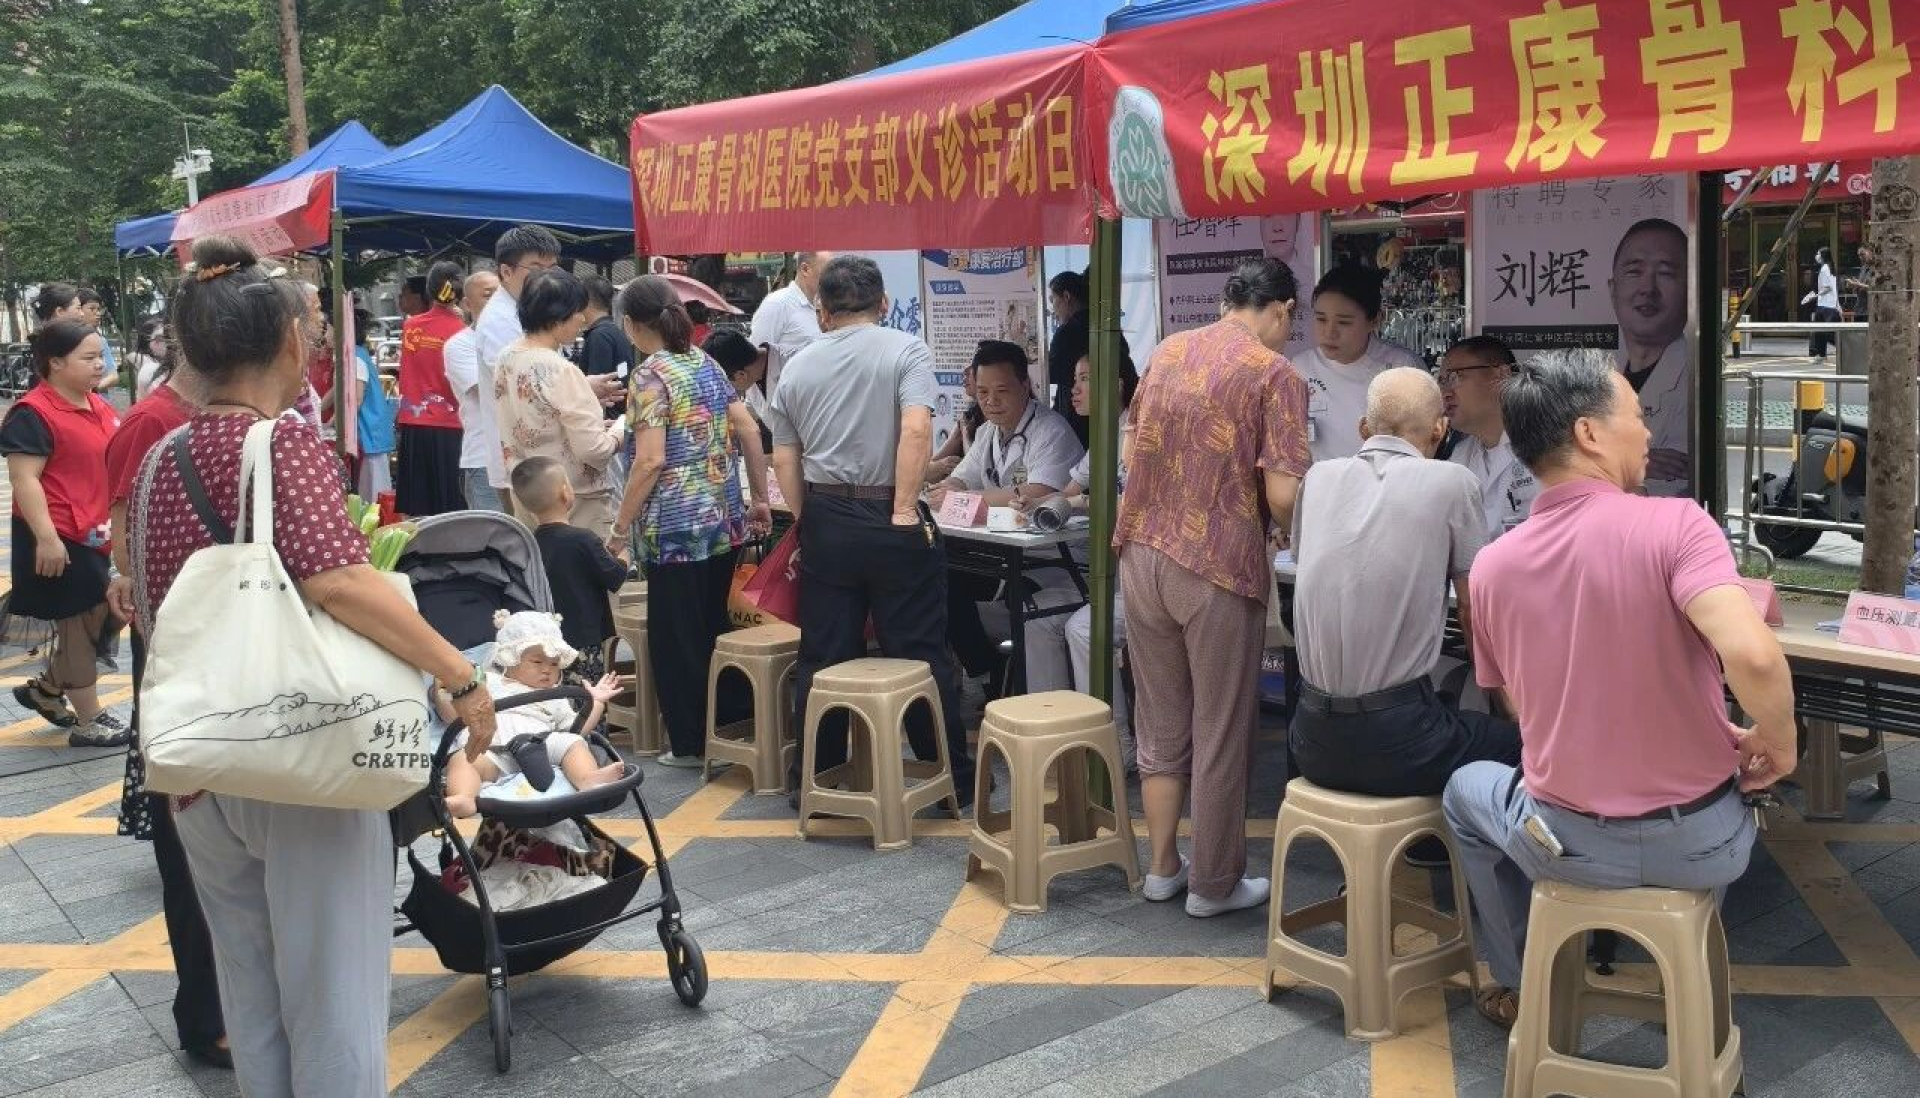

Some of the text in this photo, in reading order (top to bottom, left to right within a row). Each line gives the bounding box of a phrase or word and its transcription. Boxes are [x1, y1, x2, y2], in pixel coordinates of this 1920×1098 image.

[1201, 0, 1912, 204] 深圳正康骨科
[1492, 248, 1591, 310] 刘辉
